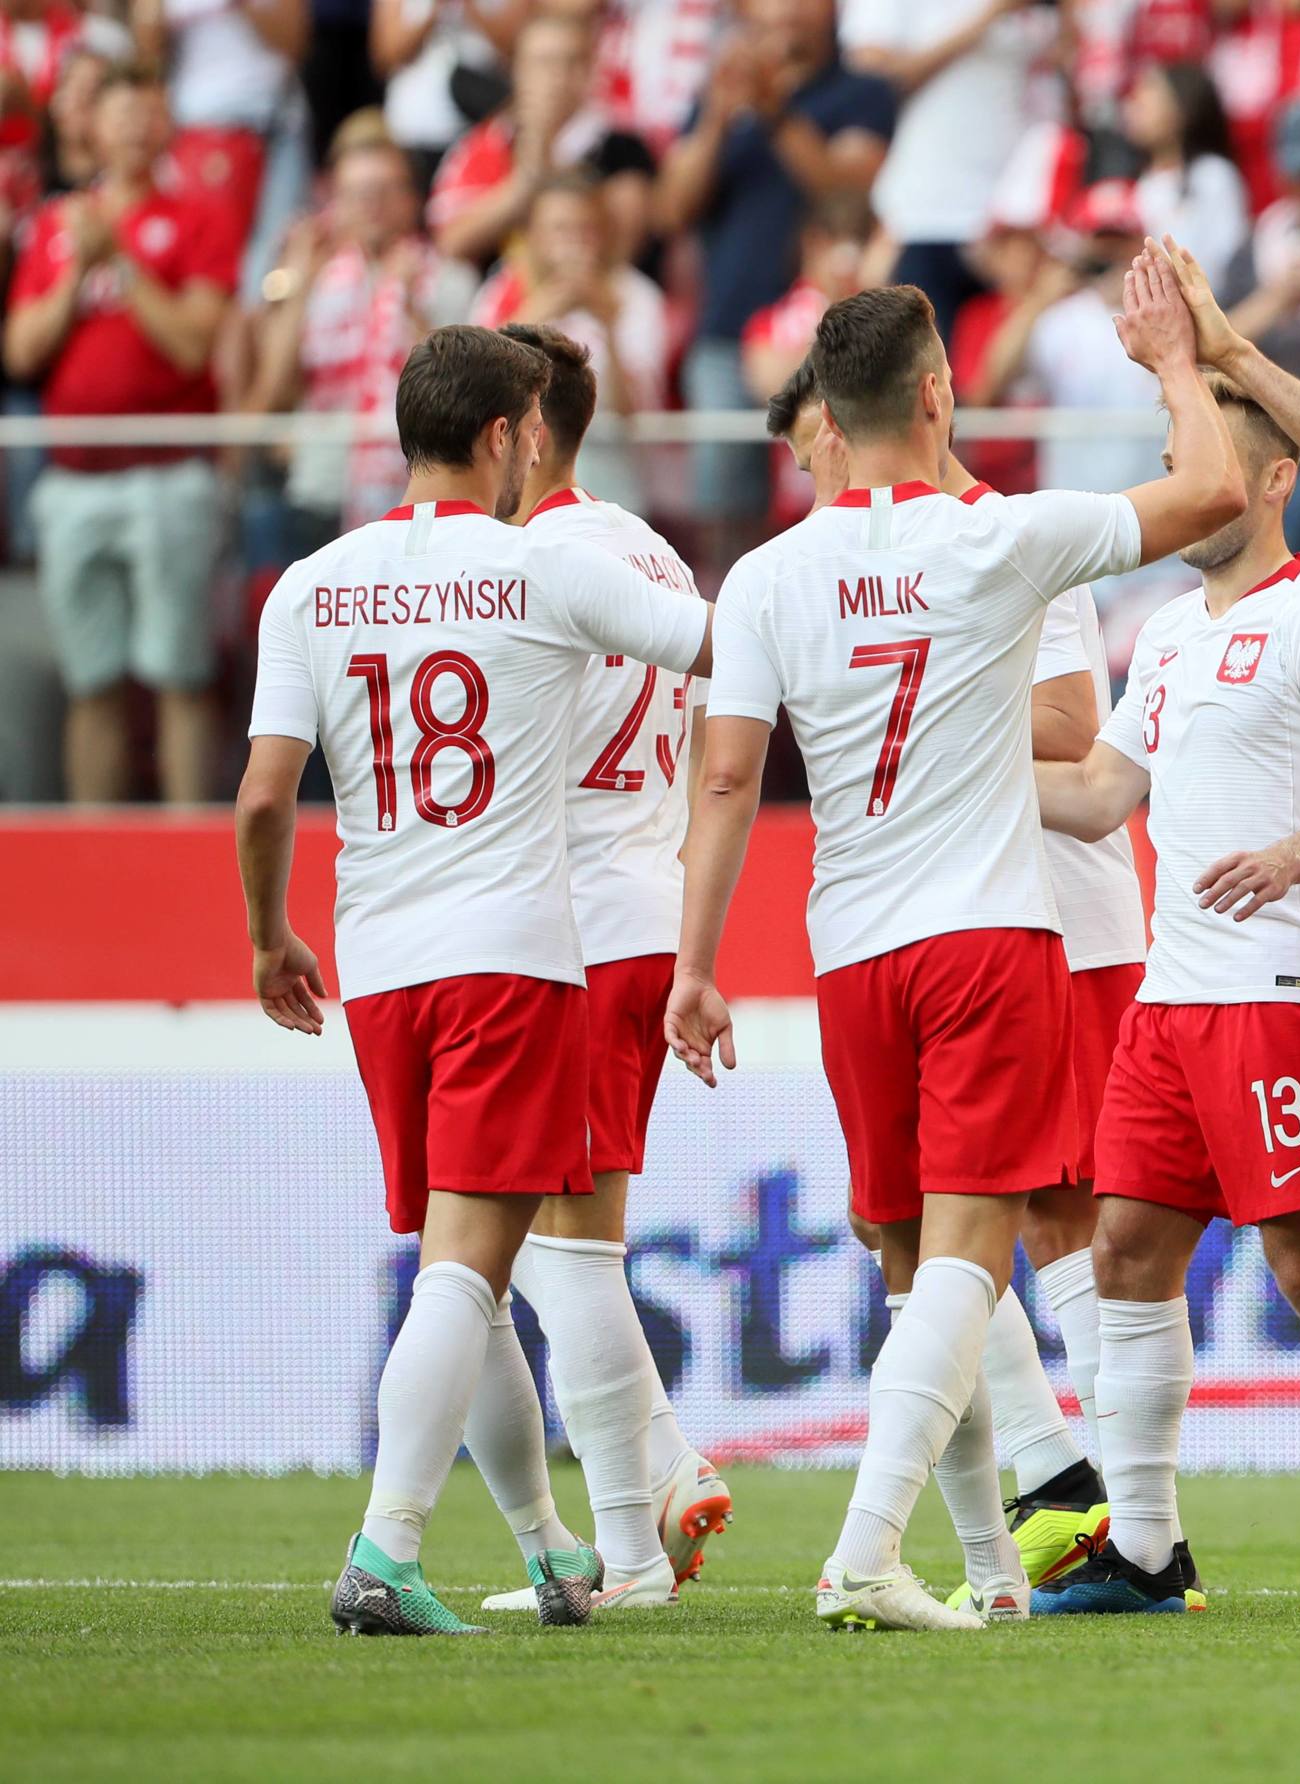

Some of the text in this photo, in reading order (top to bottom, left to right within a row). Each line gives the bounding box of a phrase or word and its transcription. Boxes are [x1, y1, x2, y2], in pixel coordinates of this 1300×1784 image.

[314, 571, 527, 628] BERESZYŃSKI
[837, 572, 930, 620] MILIK
[346, 649, 496, 832] 18
[848, 637, 932, 817] 7
